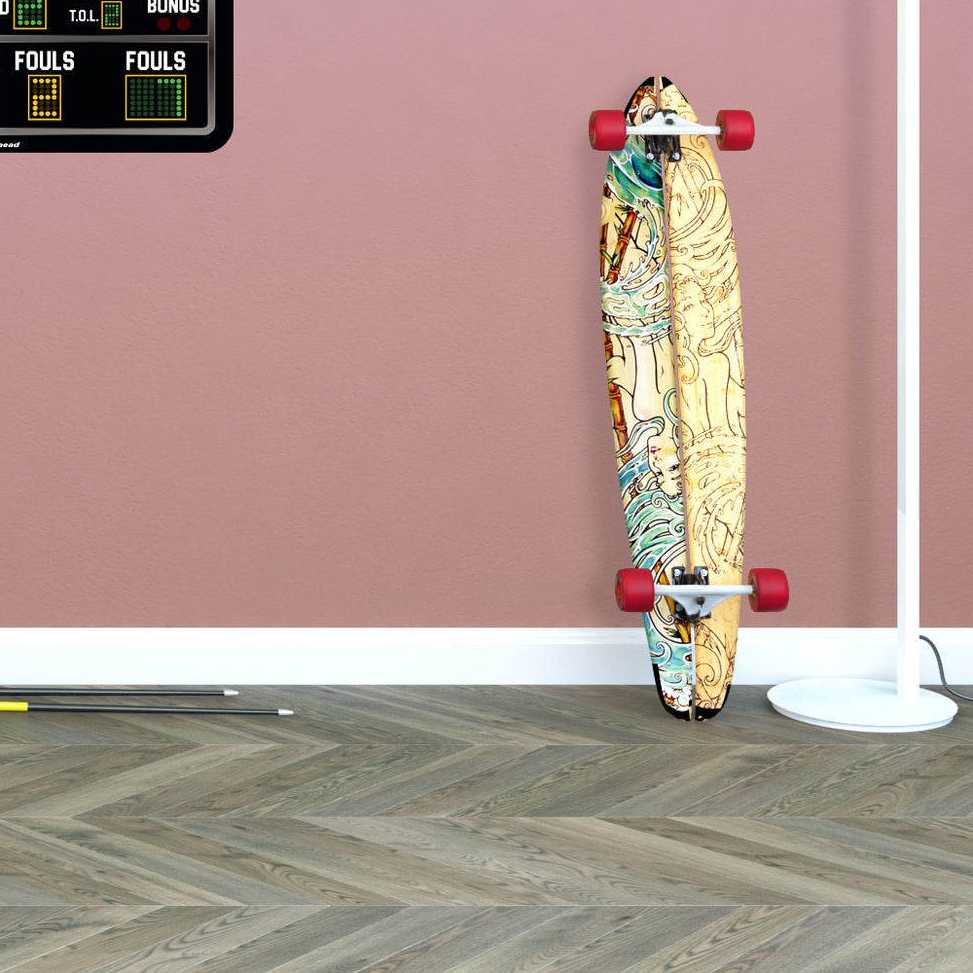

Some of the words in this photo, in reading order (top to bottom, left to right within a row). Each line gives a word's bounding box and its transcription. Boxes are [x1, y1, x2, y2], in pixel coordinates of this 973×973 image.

[69, 9, 99, 22] T.O.L.
[15, 50, 75, 71] FOULS
[126, 50, 186, 71] FOULS
[32, 78, 57, 117] 2
